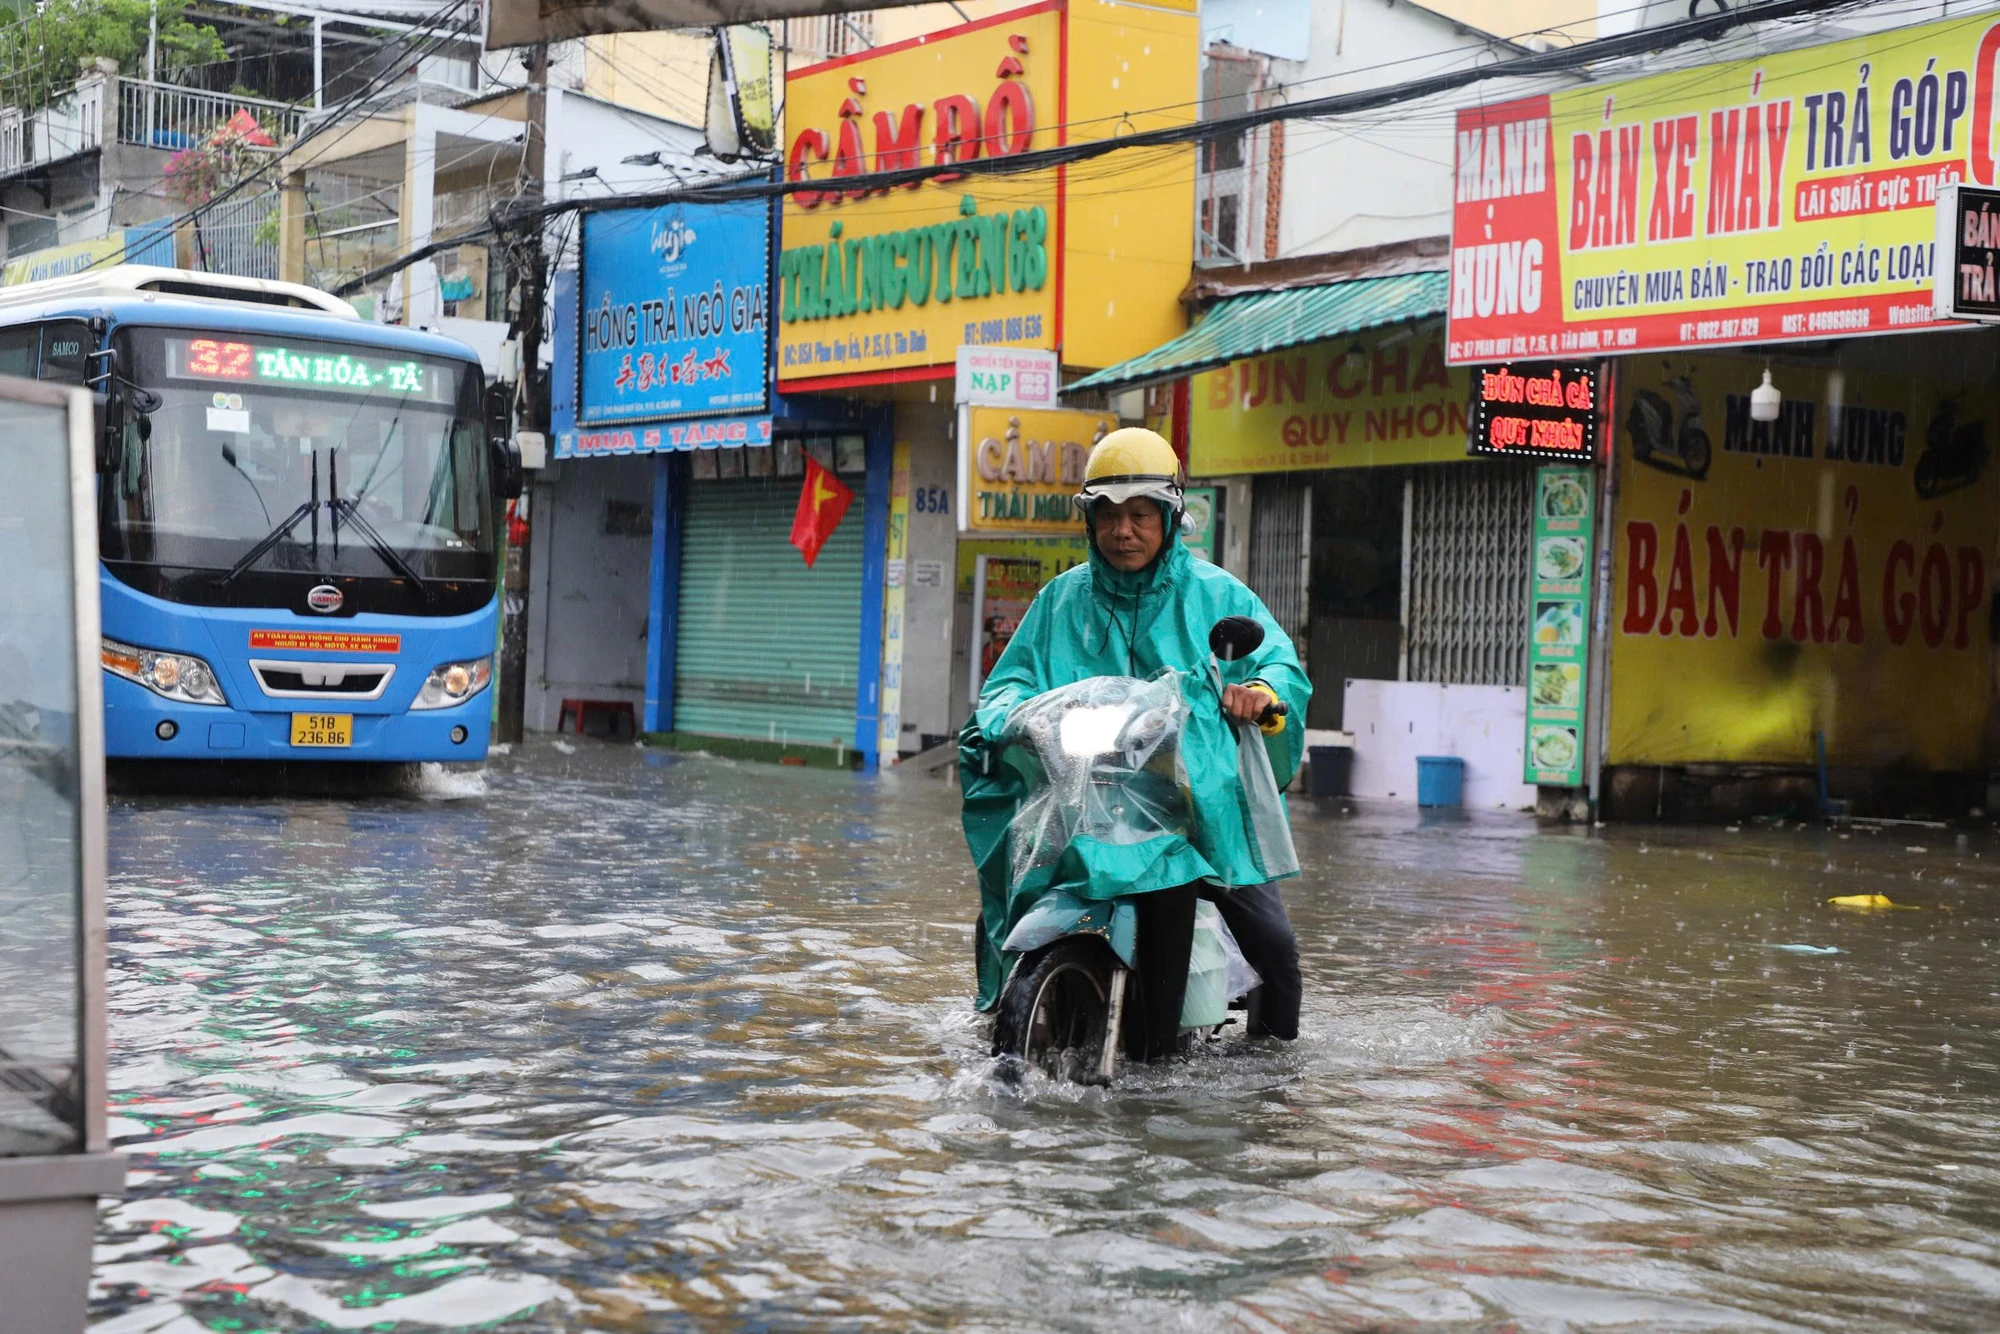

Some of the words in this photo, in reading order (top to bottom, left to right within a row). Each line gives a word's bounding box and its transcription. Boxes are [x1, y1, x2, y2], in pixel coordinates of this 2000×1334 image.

[788, 76, 925, 209] CẦM
[931, 34, 1036, 183] ĐỒ
[1456, 117, 1548, 220] MẠNH
[1568, 96, 1642, 251] BÁN
[1648, 115, 1698, 242] XE
[1706, 72, 1791, 235] MÁY
[1804, 63, 1871, 171] TRẢ
[1889, 58, 1968, 160] GÓP
[1800, 184, 1826, 217] LÃI
[1830, 175, 1873, 214] SUẤT
[1878, 174, 1910, 212] CỰC
[779, 220, 859, 324] THÁI
[858, 194, 1009, 312] NGUYÊN
[1008, 205, 1048, 294] 68
[1451, 223, 1544, 320] HÙNG
[1574, 270, 1639, 310] CHUYÊN
[1645, 270, 1683, 303] MUA
[1691, 260, 1727, 298] BÁN
[1745, 258, 1792, 294] TRAO
[1800, 241, 1832, 288] ĐỔI
[1841, 243, 1880, 285] CÁC
[1887, 242, 1935, 285] LOẠI
[1960, 251, 1996, 303] TRẢ
[586, 291, 637, 353] HỒNG
[641, 287, 679, 346] TRÀ
[683, 279, 725, 341] NGÔ
[731, 284, 766, 333] GIA
[52, 341, 79, 357] SAMCO
[189, 339, 250, 377] 32
[256, 347, 310, 381] TÂN
[313, 354, 371, 388] HÓA
[970, 371, 1012, 395] NẠP
[1483, 368, 1525, 403] BÚN
[1525, 369, 1564, 407] CHẢ
[578, 430, 635, 450] MUA
[643, 428, 660, 446] 5
[669, 421, 747, 447] TẶNG
[757, 421, 772, 439] 1
[1281, 411, 1353, 448] QUY
[1364, 398, 1468, 443] NHƠN
[1489, 416, 1530, 449] QUY
[977, 415, 1056, 485] CẦM
[915, 486, 949, 515] 85A
[977, 487, 1028, 520] THÁI
[1622, 487, 1746, 640] BÁN
[1758, 483, 1866, 646] TRẢ
[1882, 508, 1985, 650] GÓP
[288, 633, 306, 641] GIAO
[308, 633, 333, 642] THÔNG
[298, 730, 345, 744] 236.86
[309, 715, 336, 730] 51B
